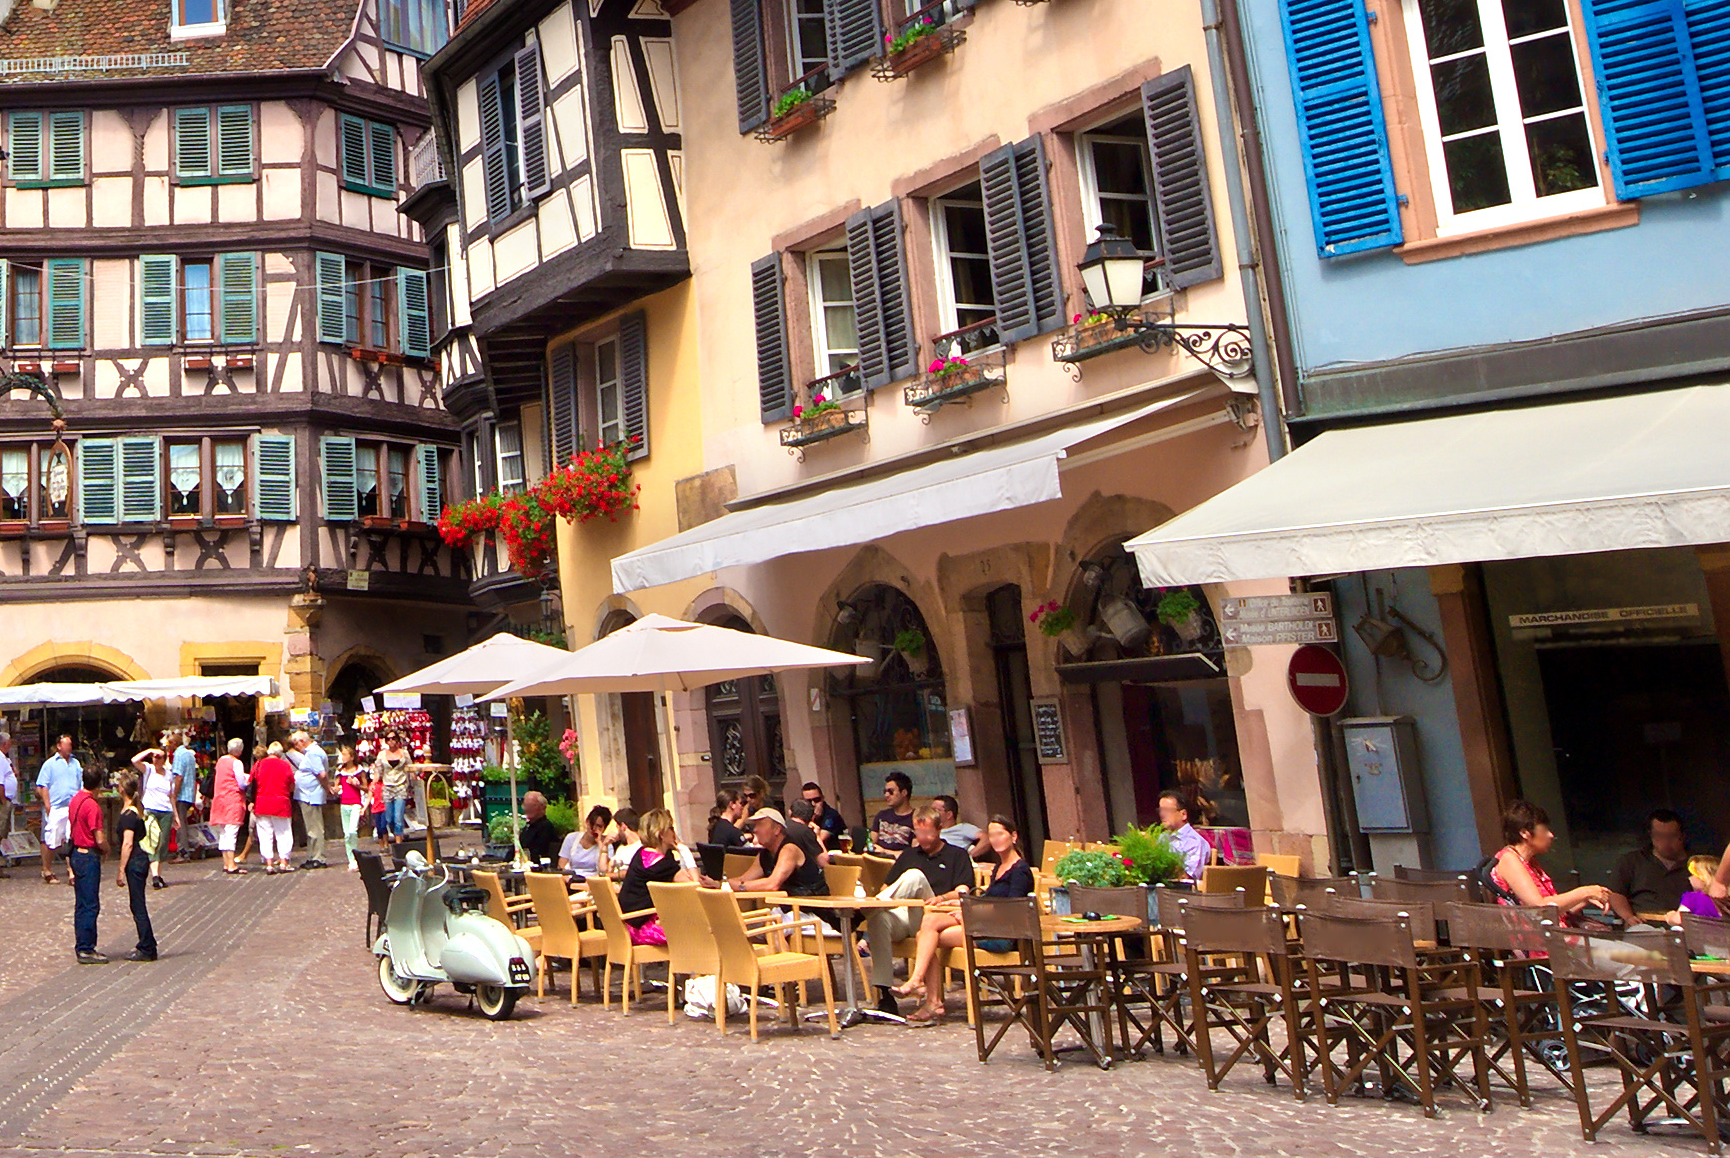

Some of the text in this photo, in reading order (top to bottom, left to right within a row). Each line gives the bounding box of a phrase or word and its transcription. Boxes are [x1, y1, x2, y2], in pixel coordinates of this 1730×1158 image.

[1519, 606, 1688, 625] MARCHANDISE OFFICIELLE
[1267, 621, 1314, 632] BARTHOLDI
[1242, 632, 1315, 643] Maison PFISTER
